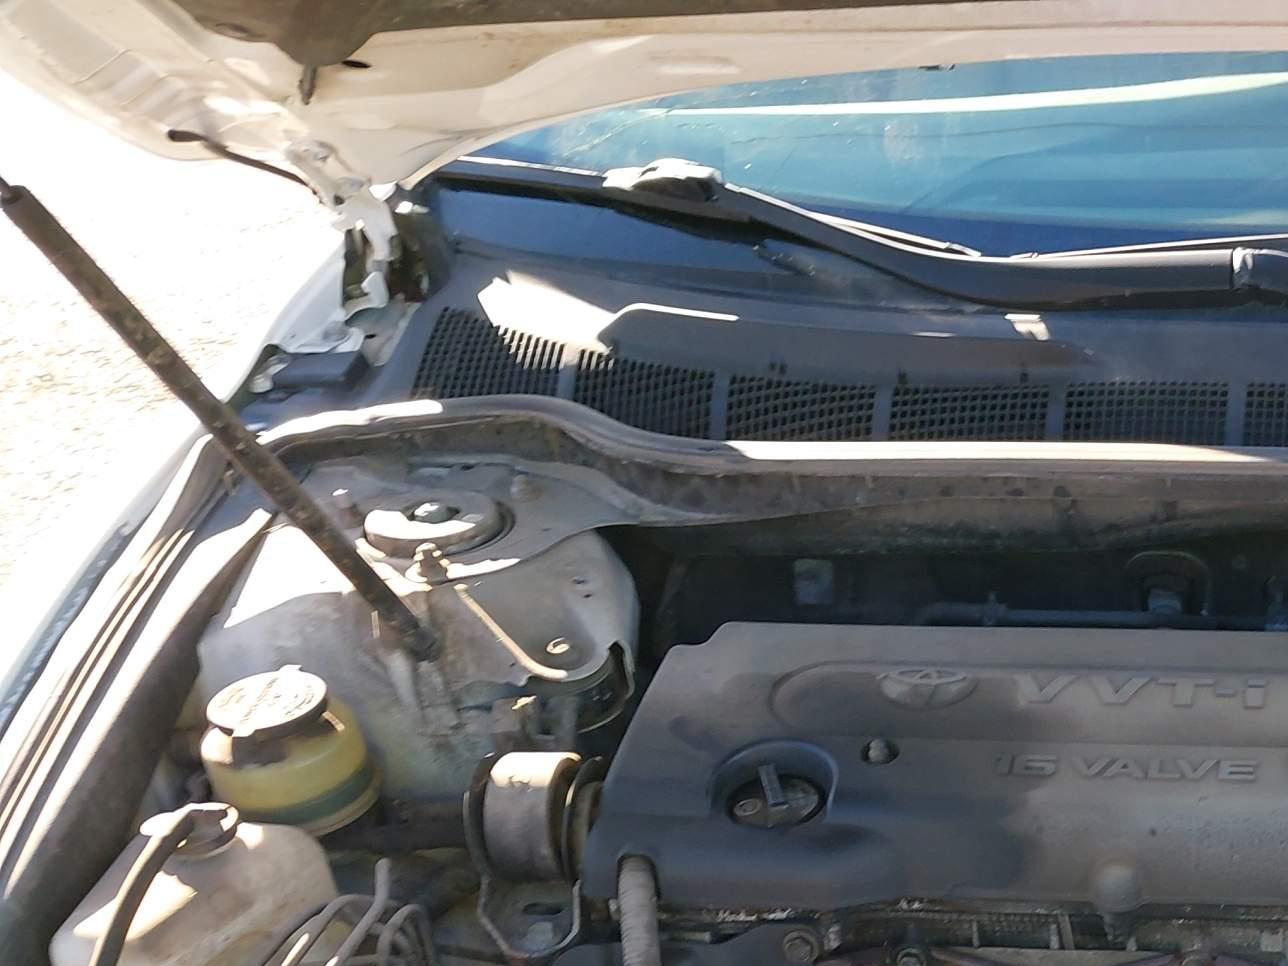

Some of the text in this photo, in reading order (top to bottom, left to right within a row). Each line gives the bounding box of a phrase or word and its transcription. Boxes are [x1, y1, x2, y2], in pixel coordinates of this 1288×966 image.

[1014, 674, 1268, 709] VVT-i
[994, 752, 1260, 781] 16 VALVE
